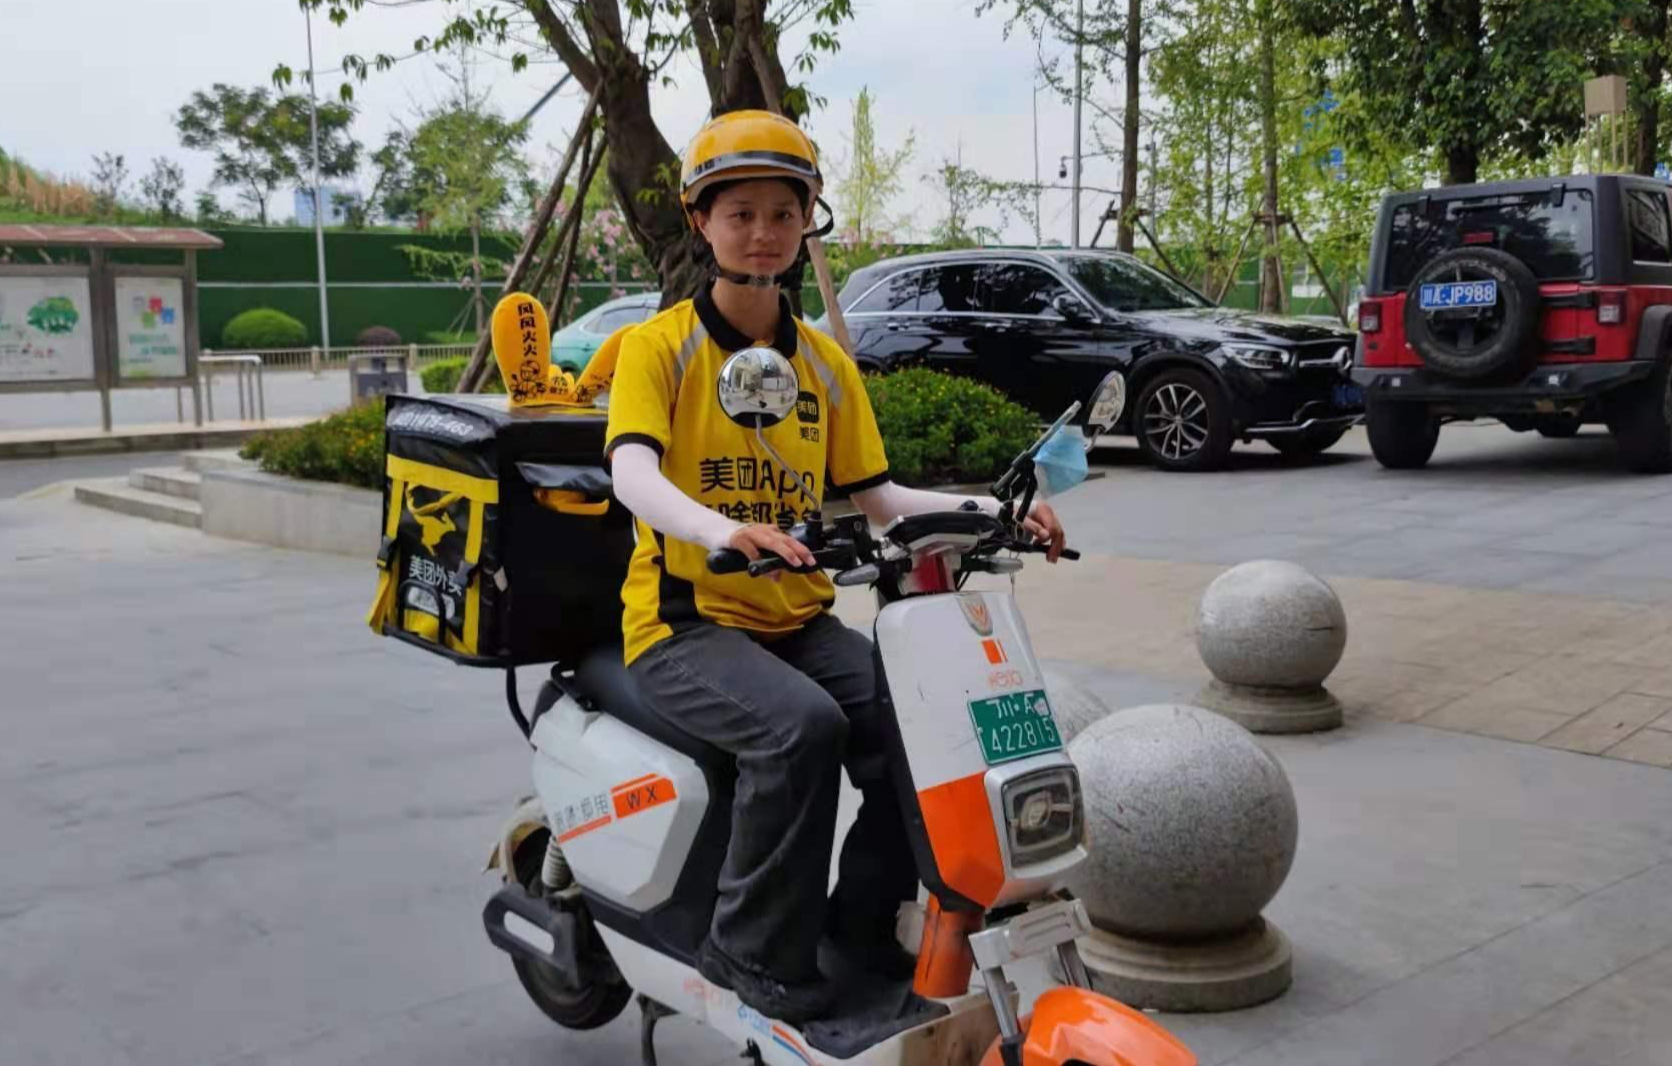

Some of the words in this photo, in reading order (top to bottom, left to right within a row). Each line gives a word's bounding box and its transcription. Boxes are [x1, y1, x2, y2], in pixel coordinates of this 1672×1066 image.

[518, 302, 538, 358] 风风火火
[800, 426, 820, 443] 美团
[699, 456, 815, 503] 美团App
[992, 716, 1056, 753] 422815
